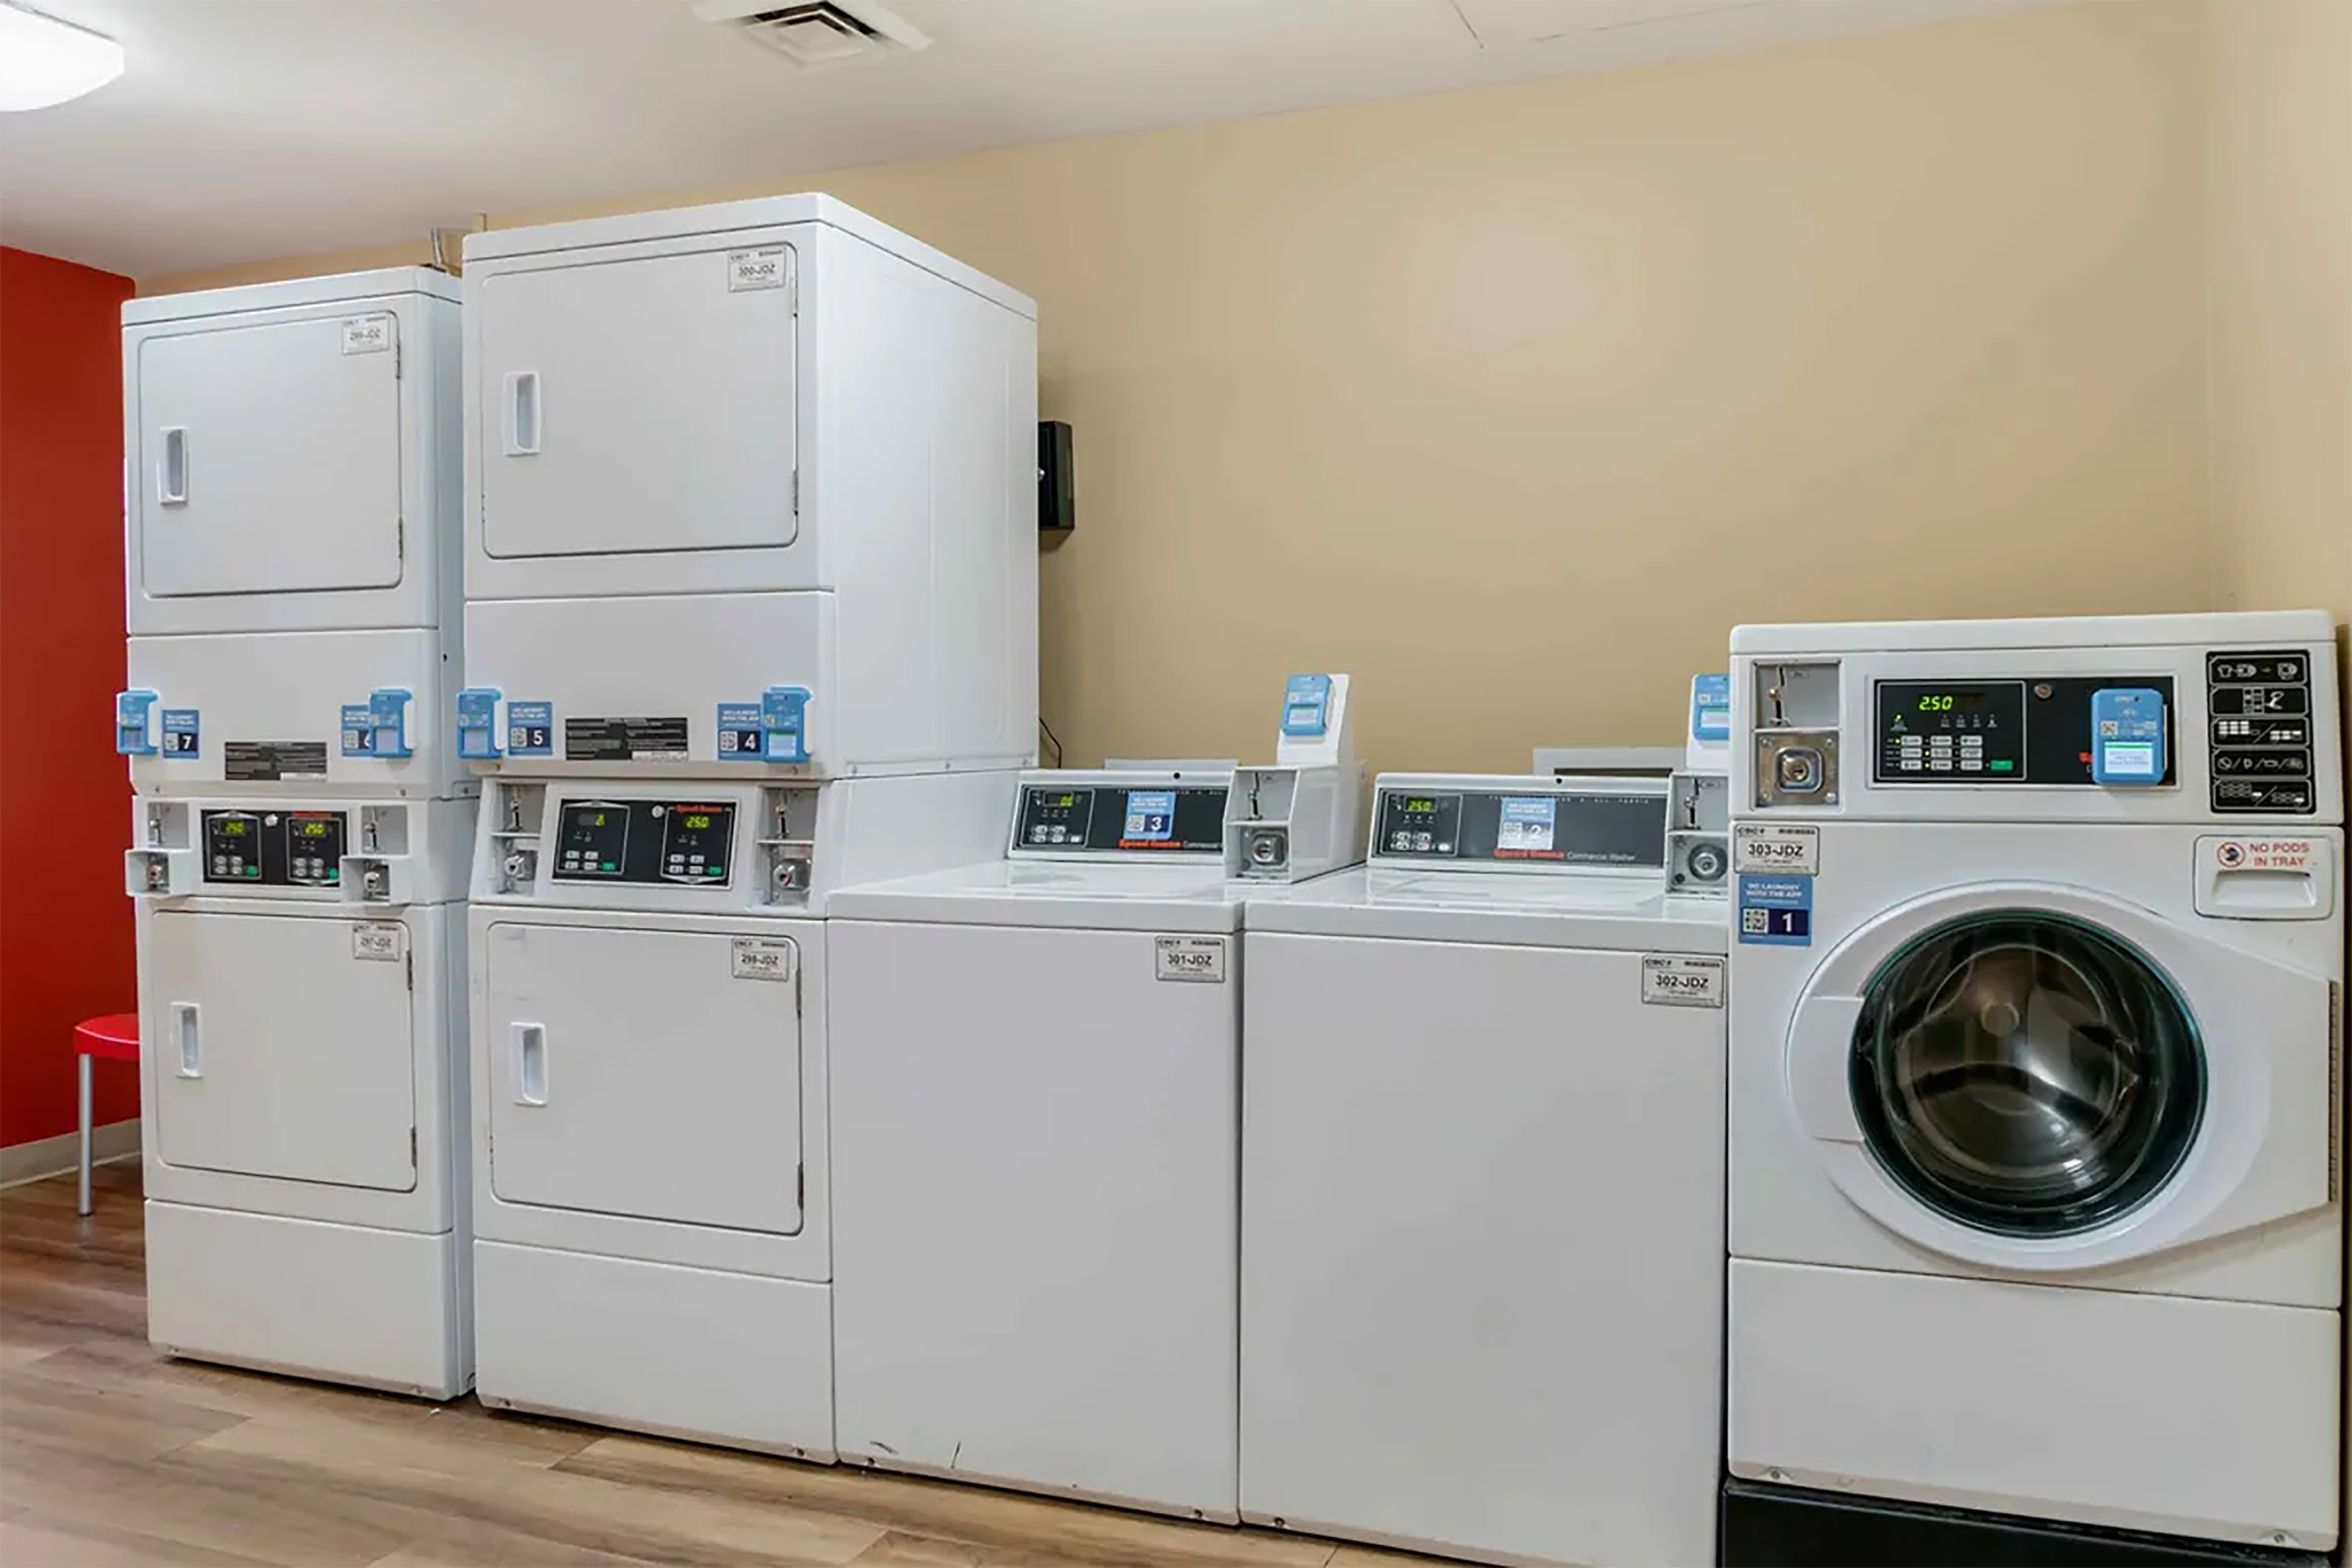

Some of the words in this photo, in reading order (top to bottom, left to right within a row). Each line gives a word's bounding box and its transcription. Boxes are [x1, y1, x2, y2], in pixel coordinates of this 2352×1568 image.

[182, 735, 192, 750] 7
[533, 730, 543, 745] 5
[745, 733, 756, 750] 4
[1151, 816, 1162, 830] 3
[1530, 824, 1542, 838] 2
[1748, 844, 1803, 857] 303-JDZ
[2249, 843, 2269, 853] NO
[2273, 843, 2310, 853] PODS
[2253, 857, 2267, 866] IN
[2271, 857, 2305, 866] TRAY
[1782, 913, 1793, 932] 1
[1168, 953, 1212, 967] 301-JDZ
[1655, 975, 1708, 989] 302-JDZ
